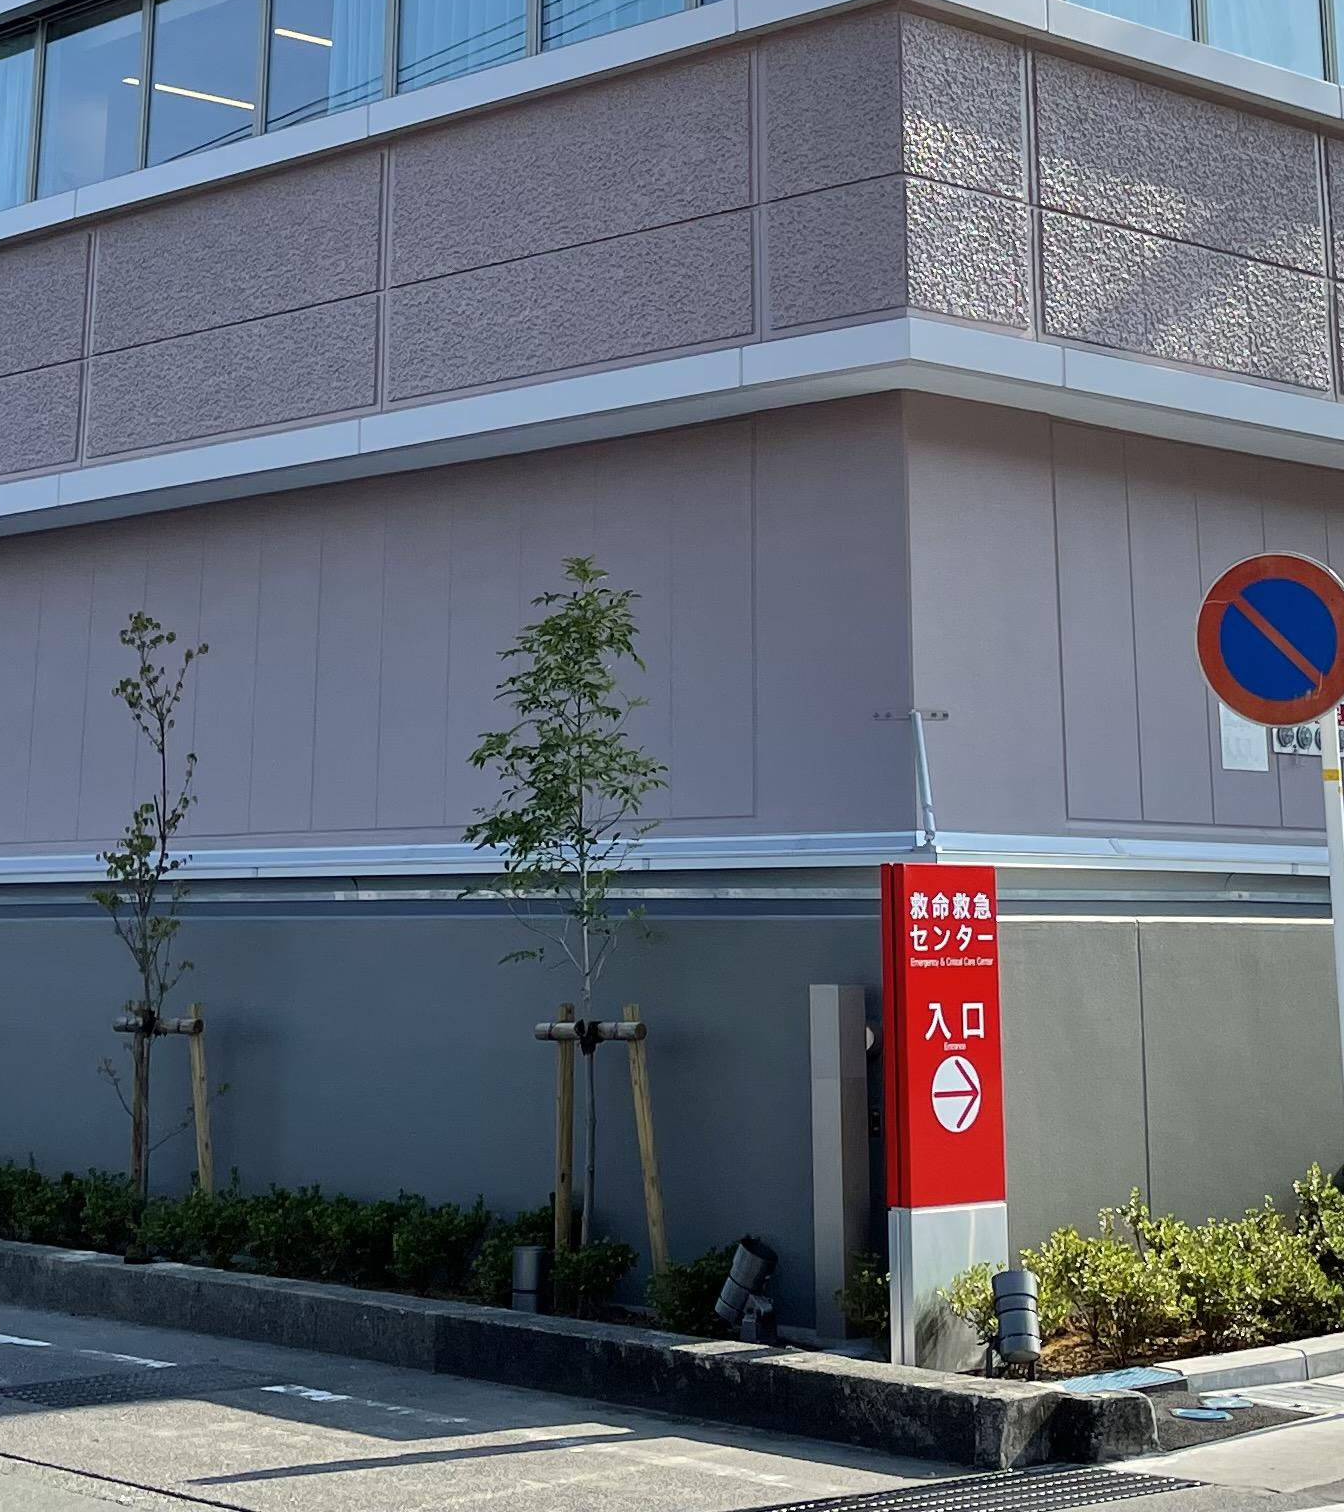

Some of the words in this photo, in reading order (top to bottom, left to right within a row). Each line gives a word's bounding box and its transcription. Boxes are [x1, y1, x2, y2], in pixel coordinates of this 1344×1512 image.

[909, 892, 992, 920] 救命救急
[909, 924, 994, 952] センター
[925, 1002, 985, 1040] 入口
